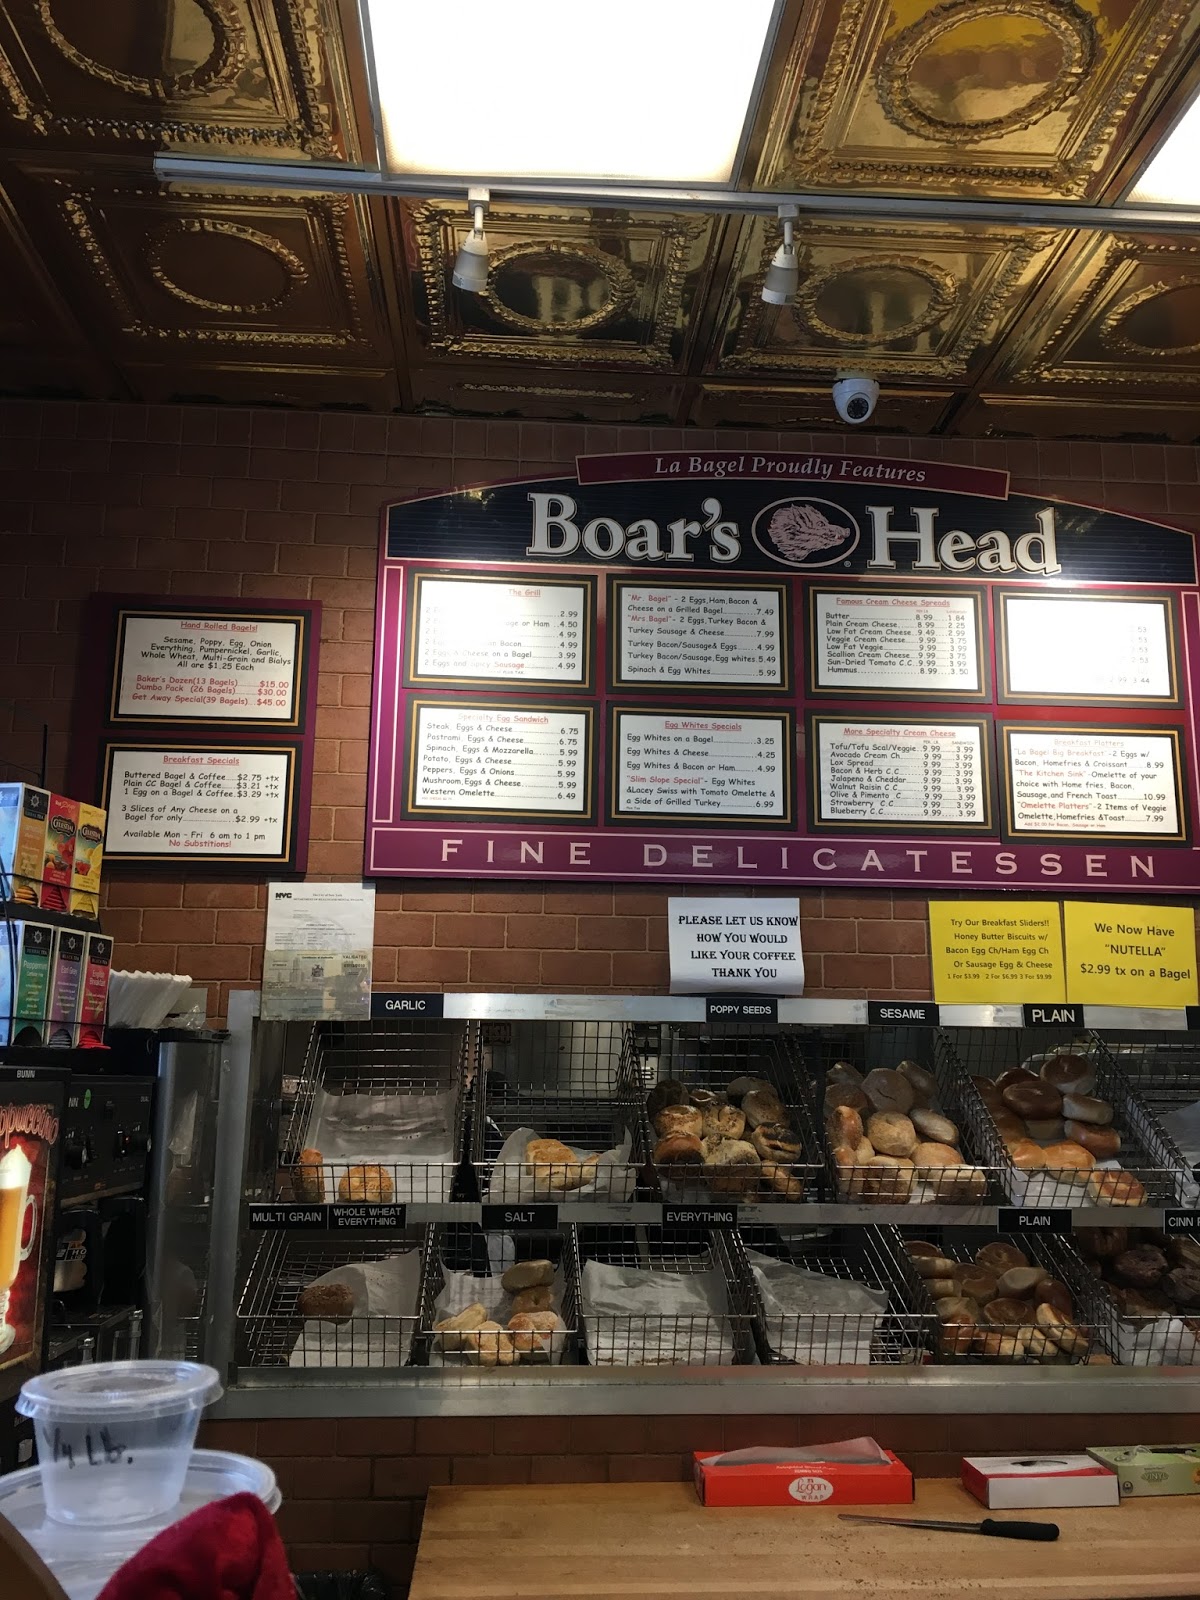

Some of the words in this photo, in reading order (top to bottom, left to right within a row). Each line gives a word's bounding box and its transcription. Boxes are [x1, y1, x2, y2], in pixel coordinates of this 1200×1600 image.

[654, 456, 681, 475] La
[687, 455, 746, 479] Bagel
[752, 456, 834, 479] Proudly
[838, 460, 927, 483] Features
[525, 492, 742, 564] Boar's
[864, 504, 1062, 577] Head
[181, 621, 200, 629] Hand
[231, 623, 258, 632] Bagels!
[164, 636, 196, 644] Sesame,
[200, 638, 224, 647] Poppy,
[229, 639, 246, 648] Egg,
[151, 644, 195, 653] Everything,
[200, 646, 252, 655] Pumpernickel,
[256, 649, 282, 657] Garlic,
[169, 653, 198, 661] Wheat,
[202, 654, 248, 662] Multi-Grain
[269, 657, 291, 665] Bialys
[137, 675, 166, 683] Baker's
[458, 713, 492, 722] Specialty
[497, 714, 510, 723] Egg
[514, 715, 548, 723] Sandwich
[665, 721, 678, 729] Egg
[712, 723, 742, 731] Specials
[866, 728, 900, 736] Specialty
[164, 756, 203, 764] Breakfast
[207, 757, 239, 765] Specials
[1110, 782, 1135, 790] Bacon,
[732, 789, 766, 797] Omelette
[171, 806, 185, 814] Any
[189, 806, 217, 814] Cheese
[184, 840, 231, 848] Substitions!
[441, 839, 591, 866] FINE
[643, 843, 1155, 879] DELICATESSEN
[678, 916, 722, 925] PLEASE
[726, 916, 746, 925] LET
[750, 917, 763, 925] US
[766, 916, 798, 926] KNOW
[951, 919, 962, 927] Try
[1095, 923, 1112, 933] We
[1117, 924, 1142, 934] Now
[1147, 926, 1174, 936] Have
[697, 933, 721, 942] HOW
[724, 933, 746, 943] YOU
[750, 933, 788, 943] WOULD
[954, 933, 978, 941] Honey
[691, 950, 717, 959] LIKE
[720, 950, 750, 960] YOUR
[753, 952, 796, 960] COFFEE
[966, 961, 996, 969] Sausage
[1000, 961, 1013, 969] Egg
[712, 968, 751, 978] THANK
[754, 967, 777, 978] YOU
[1080, 963, 1110, 974] $2.99
[1115, 966, 1126, 975] tx
[1160, 968, 1190, 981] Bagel
[385, 1000, 426, 1010] GARLIC
[710, 1005, 739, 1014] POPPY
[743, 1006, 772, 1014] SEEDS
[879, 1007, 925, 1019] SESAME
[1032, 1009, 1075, 1022] PLAIN
[17, 1070, 35, 1078] BUNN
[252, 1212, 285, 1222] MULTI
[289, 1212, 322, 1222] GRAIN
[333, 1208, 366, 1217] WHOLE
[369, 1208, 401, 1217] WHEAT
[505, 1212, 535, 1223] SALT
[666, 1212, 733, 1223] EVERYTHING
[338, 1217, 396, 1226] EVERYTHING
[1019, 1216, 1050, 1226] PLAIN
[1168, 1217, 1193, 1227] CINN
